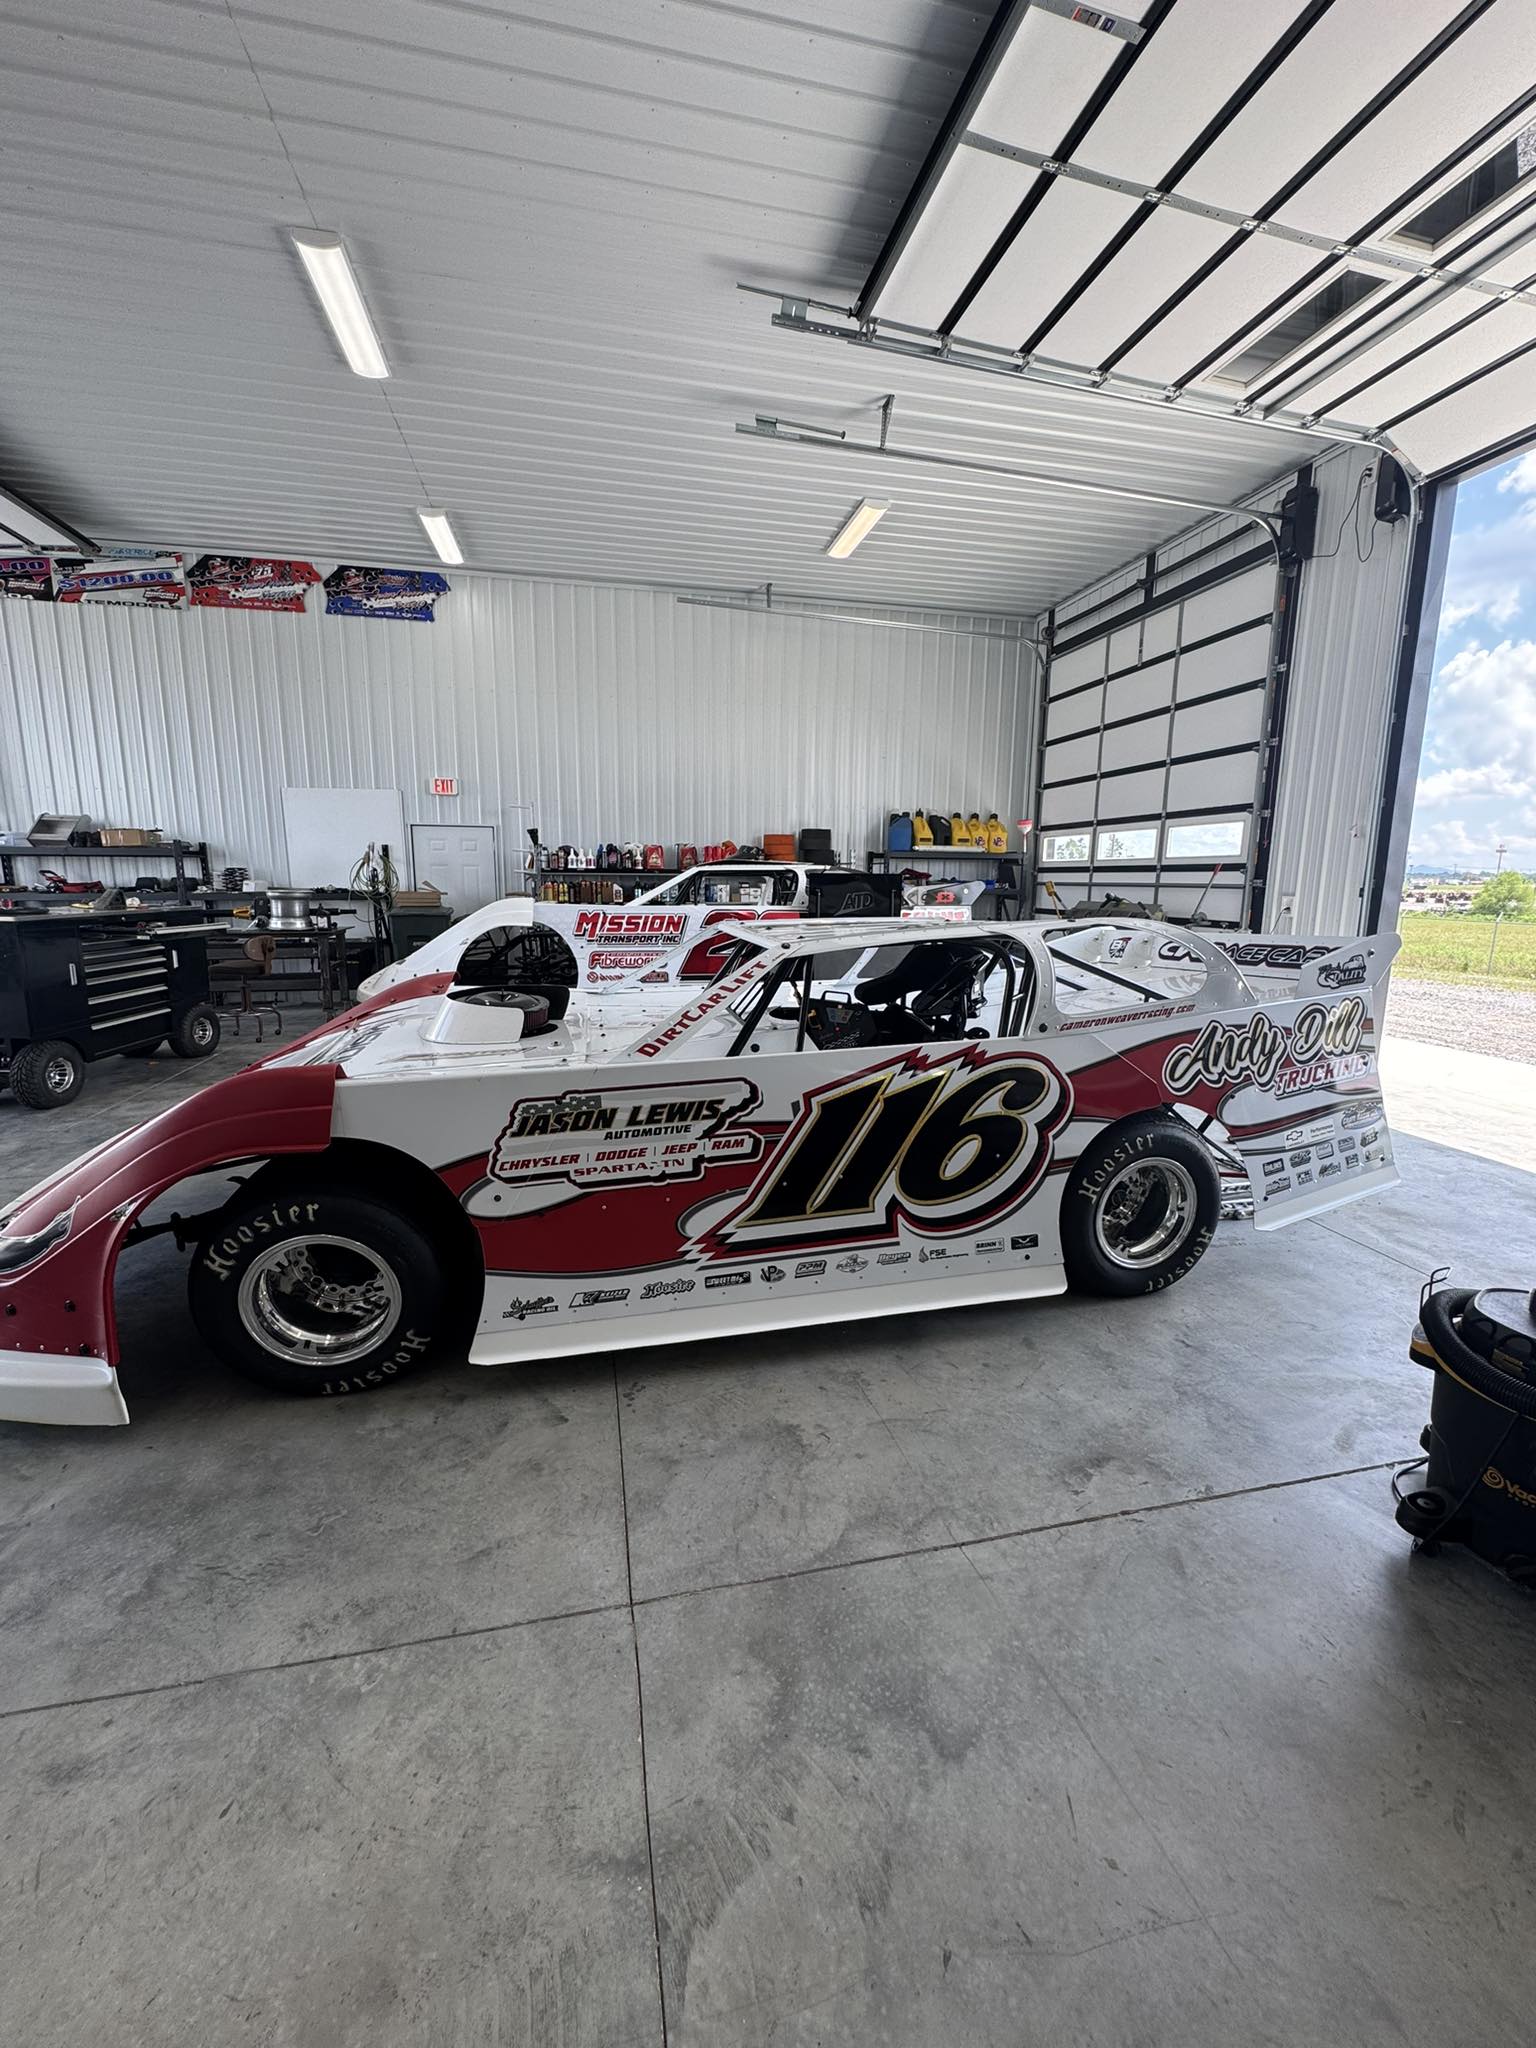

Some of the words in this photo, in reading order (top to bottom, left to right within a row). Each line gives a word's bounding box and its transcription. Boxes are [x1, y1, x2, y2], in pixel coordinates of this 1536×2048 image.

[57, 570, 174, 590] $1200.00
[434, 779, 454, 793] EXIT
[575, 911, 684, 939] MISSION
[597, 935, 661, 945] TRANSPORT
[662, 935, 681, 944] INC
[1059, 1004, 1196, 1032] cameronweaverracing.com
[1166, 1014, 1283, 1087] Andy
[1292, 998, 1362, 1060] Dill
[1275, 1055, 1369, 1095] TRUCKING
[510, 1107, 618, 1138] JASON
[626, 1098, 726, 1128] LEWIS
[604, 1124, 692, 1141] AUTOMOTIVE
[734, 1064, 1050, 1228] 116
[499, 1154, 580, 1172] CHRYSLER
[595, 1147, 648, 1162] DODGE
[661, 1143, 698, 1155] JEEP
[711, 1138, 745, 1150] RAM
[661, 1158, 685, 1168] TN
[1078, 1133, 1155, 1205] Hoosier
[203, 1202, 320, 1280] Hoosier
[929, 1248, 947, 1256] FSE
[799, 1262, 823, 1271] PPM
[1145, 1226, 1214, 1293] Hoosier
[640, 1278, 696, 1299] Hoosier
[321, 1328, 431, 1395] Hoosier
